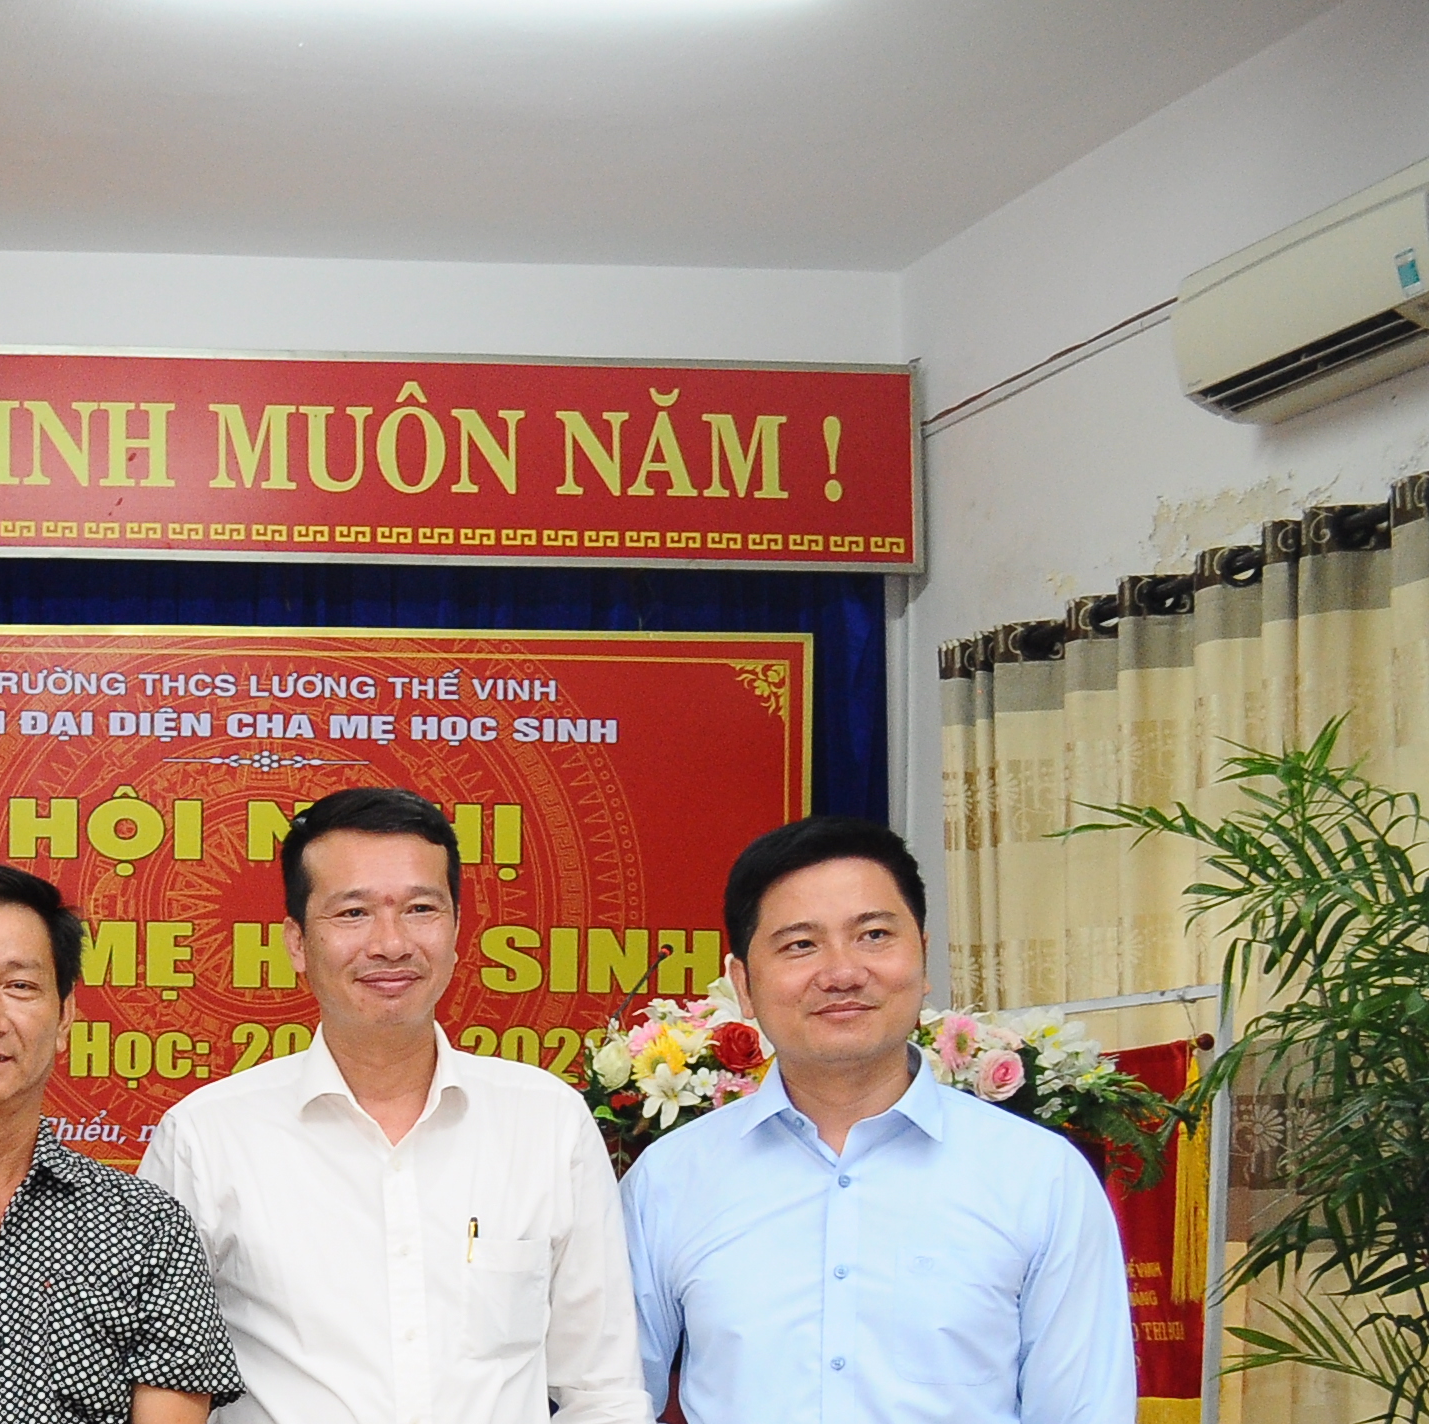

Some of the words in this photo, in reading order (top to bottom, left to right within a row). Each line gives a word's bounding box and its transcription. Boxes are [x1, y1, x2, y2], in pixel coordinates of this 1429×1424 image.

[209, 381, 525, 495] MUÔN
[556, 388, 789, 500] NĂM
[821, 415, 844, 502] !
[139, 672, 237, 698] THCS
[249, 673, 376, 700] LƯƠNG
[388, 668, 460, 701] THẾ
[472, 678, 558, 702] VINH
[19, 709, 93, 741] ĐẠI
[108, 707, 212, 742] DIỆN
[226, 713, 315, 739] CHA
[329, 714, 395, 745] MẸ
[410, 715, 499, 746] HỌC
[512, 717, 618, 744] SINH
[7, 784, 202, 877] HỘI
[247, 799, 523, 882] NHỊ
[79, 920, 195, 1001] MẸ
[479, 924, 722, 996] SINH
